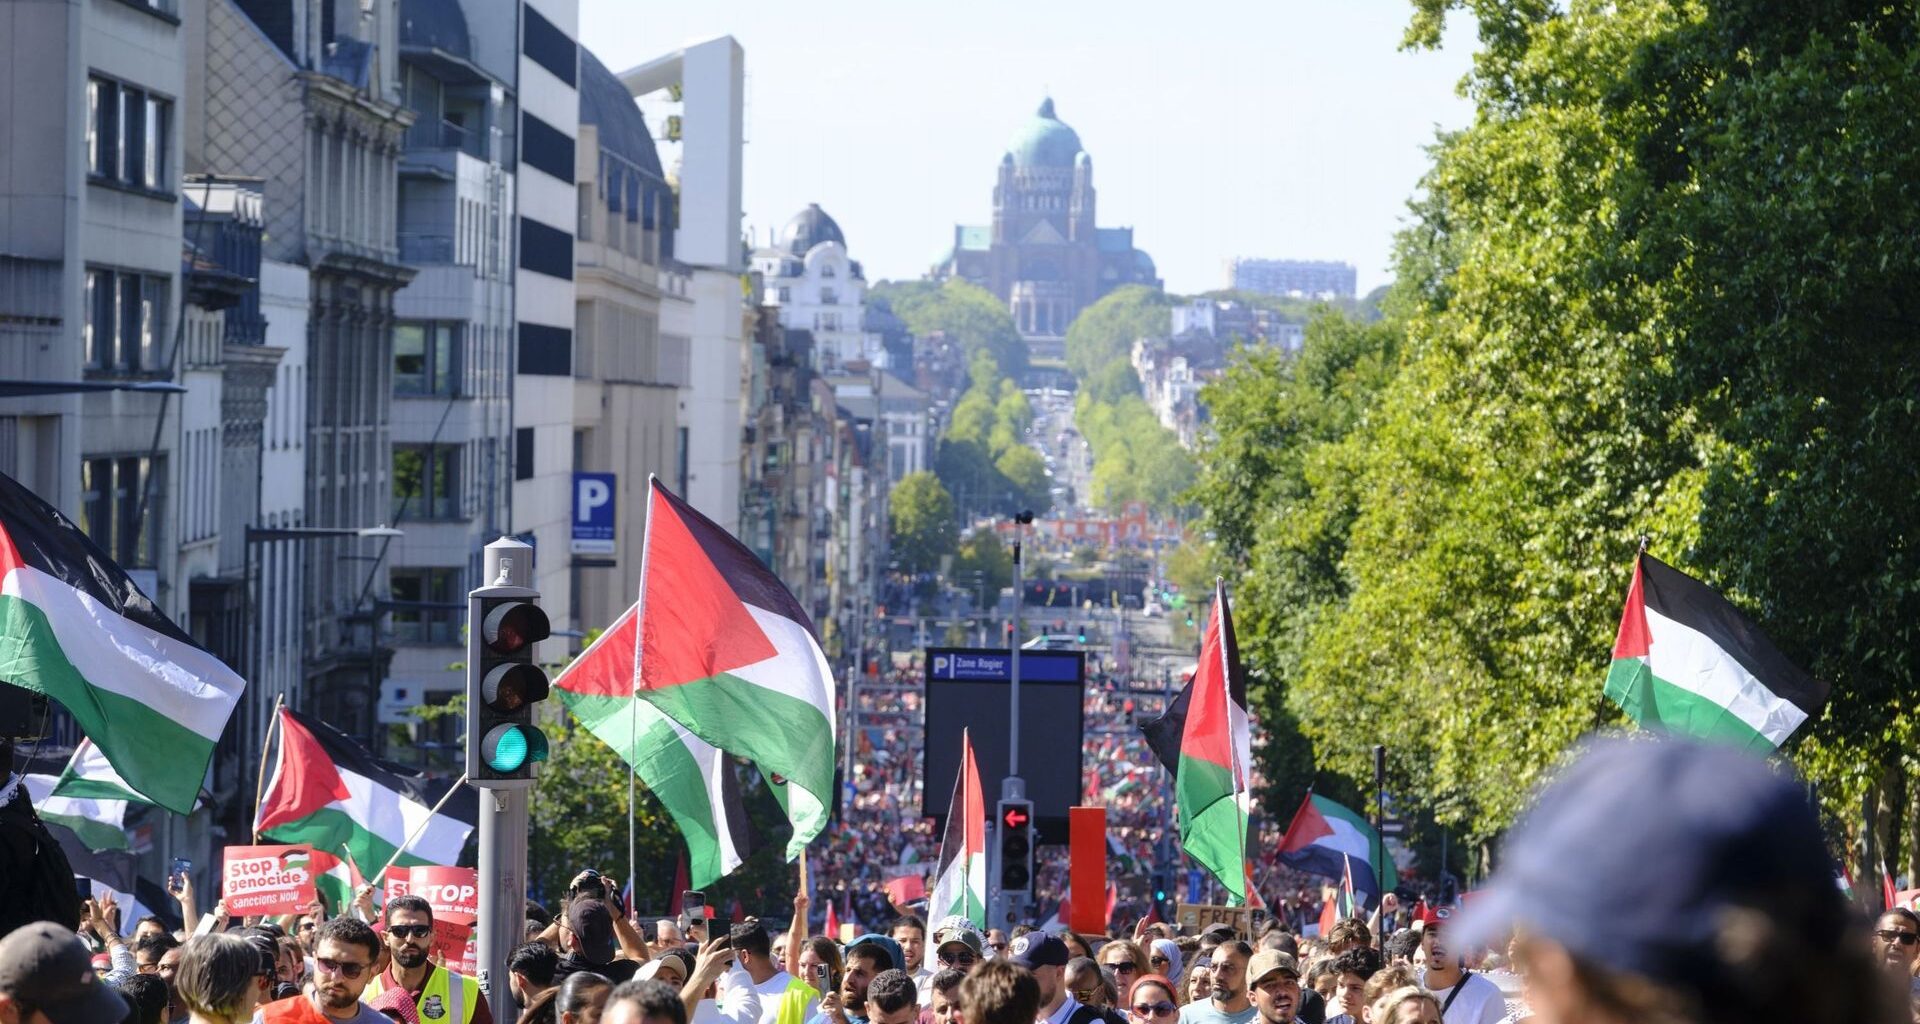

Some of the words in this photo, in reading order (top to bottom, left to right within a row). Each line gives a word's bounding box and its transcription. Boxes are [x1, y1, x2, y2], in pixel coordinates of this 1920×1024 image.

[579, 480, 609, 521] P
[934, 657, 948, 674] P
[956, 658, 976, 668] Zone
[978, 658, 1004, 671] Rogier
[231, 860, 272, 877] Stop
[229, 872, 301, 892] genocide
[232, 894, 277, 909] sanctions
[280, 890, 299, 903] NOW
